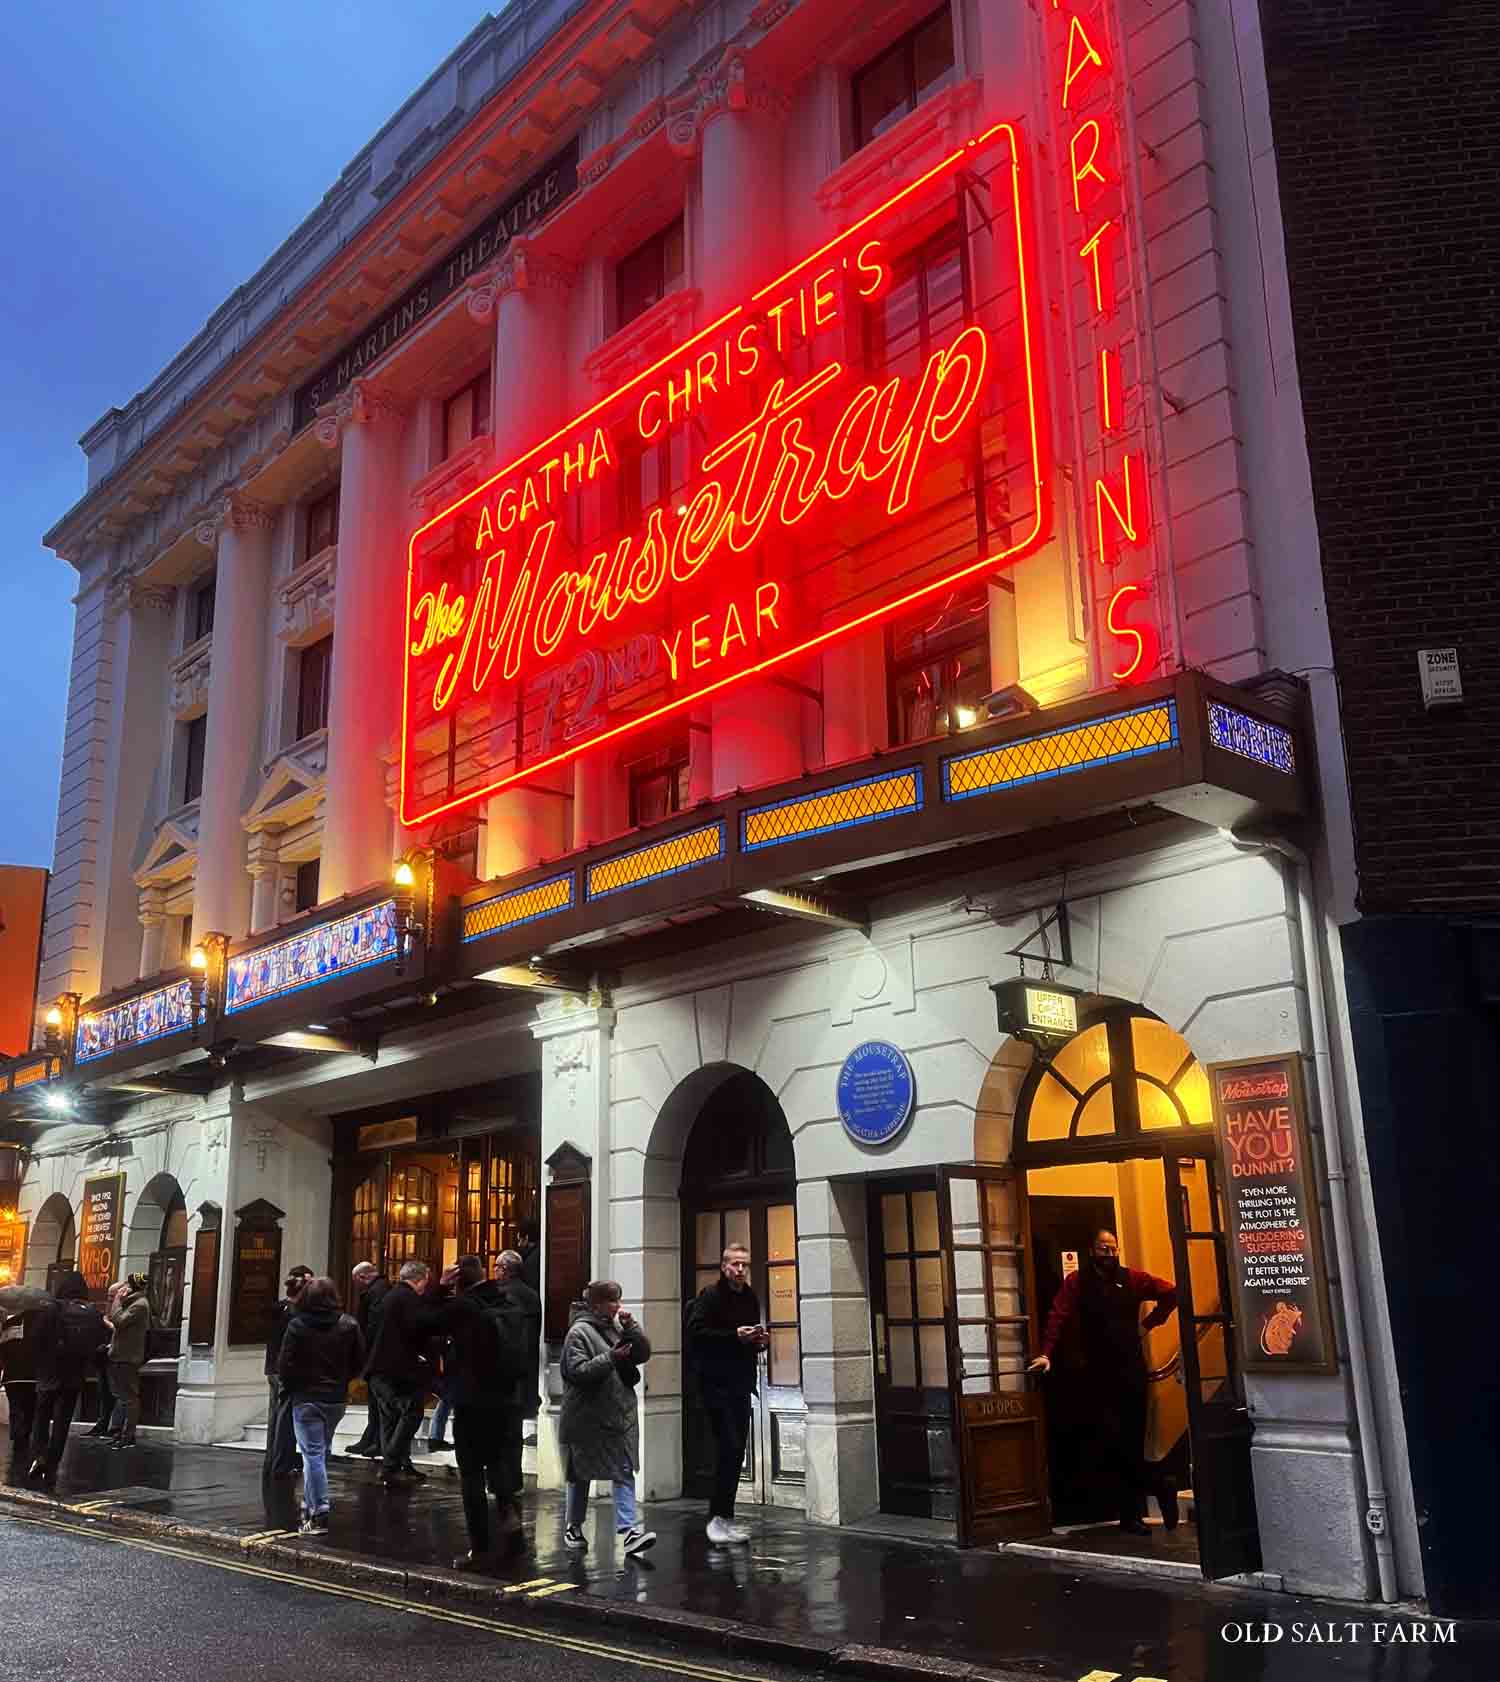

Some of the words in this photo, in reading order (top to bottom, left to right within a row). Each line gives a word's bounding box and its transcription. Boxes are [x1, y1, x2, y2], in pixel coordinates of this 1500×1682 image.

[336, 288, 430, 385] MARTINS
[447, 169, 559, 289] THEATRE
[1053, 0, 1142, 678] ARTINS
[475, 427, 610, 551] AGATHA
[638, 241, 882, 439] CHRISTIE'S
[433, 327, 987, 711] Mousetrap
[411, 582, 465, 656] The
[661, 580, 781, 681] YEAR
[1427, 653, 1456, 664] ZONE
[855, 1044, 907, 1079] MOUSETRAP
[1226, 1107, 1291, 1134] HAVE
[1225, 1130, 1293, 1160] YOU
[1232, 1158, 1296, 1177] DUNNIT?
[1265, 1185, 1288, 1197] MORE
[1238, 1199, 1273, 1209] THRILLING
[1274, 1197, 1297, 1206] THAN
[1240, 1211, 1254, 1219] THE
[1255, 1210, 1272, 1218] PLOT
[1274, 1209, 1281, 1217] IS
[1282, 1208, 1297, 1216] THE
[1239, 1220, 1288, 1231] ATMOSPHERE
[1288, 1219, 1300, 1228] OF
[1239, 1230, 1305, 1243] SHUDDERING
[81, 1247, 112, 1273] WHO
[1244, 1256, 1258, 1264] NO
[1259, 1255, 1277, 1263] ONE
[1278, 1254, 1305, 1263] BREWS
[1247, 1267, 1254, 1275] IT
[1255, 1267, 1280, 1275] BETTER
[1281, 1266, 1303, 1274] THAN
[1243, 1278, 1275, 1287] AGATHA
